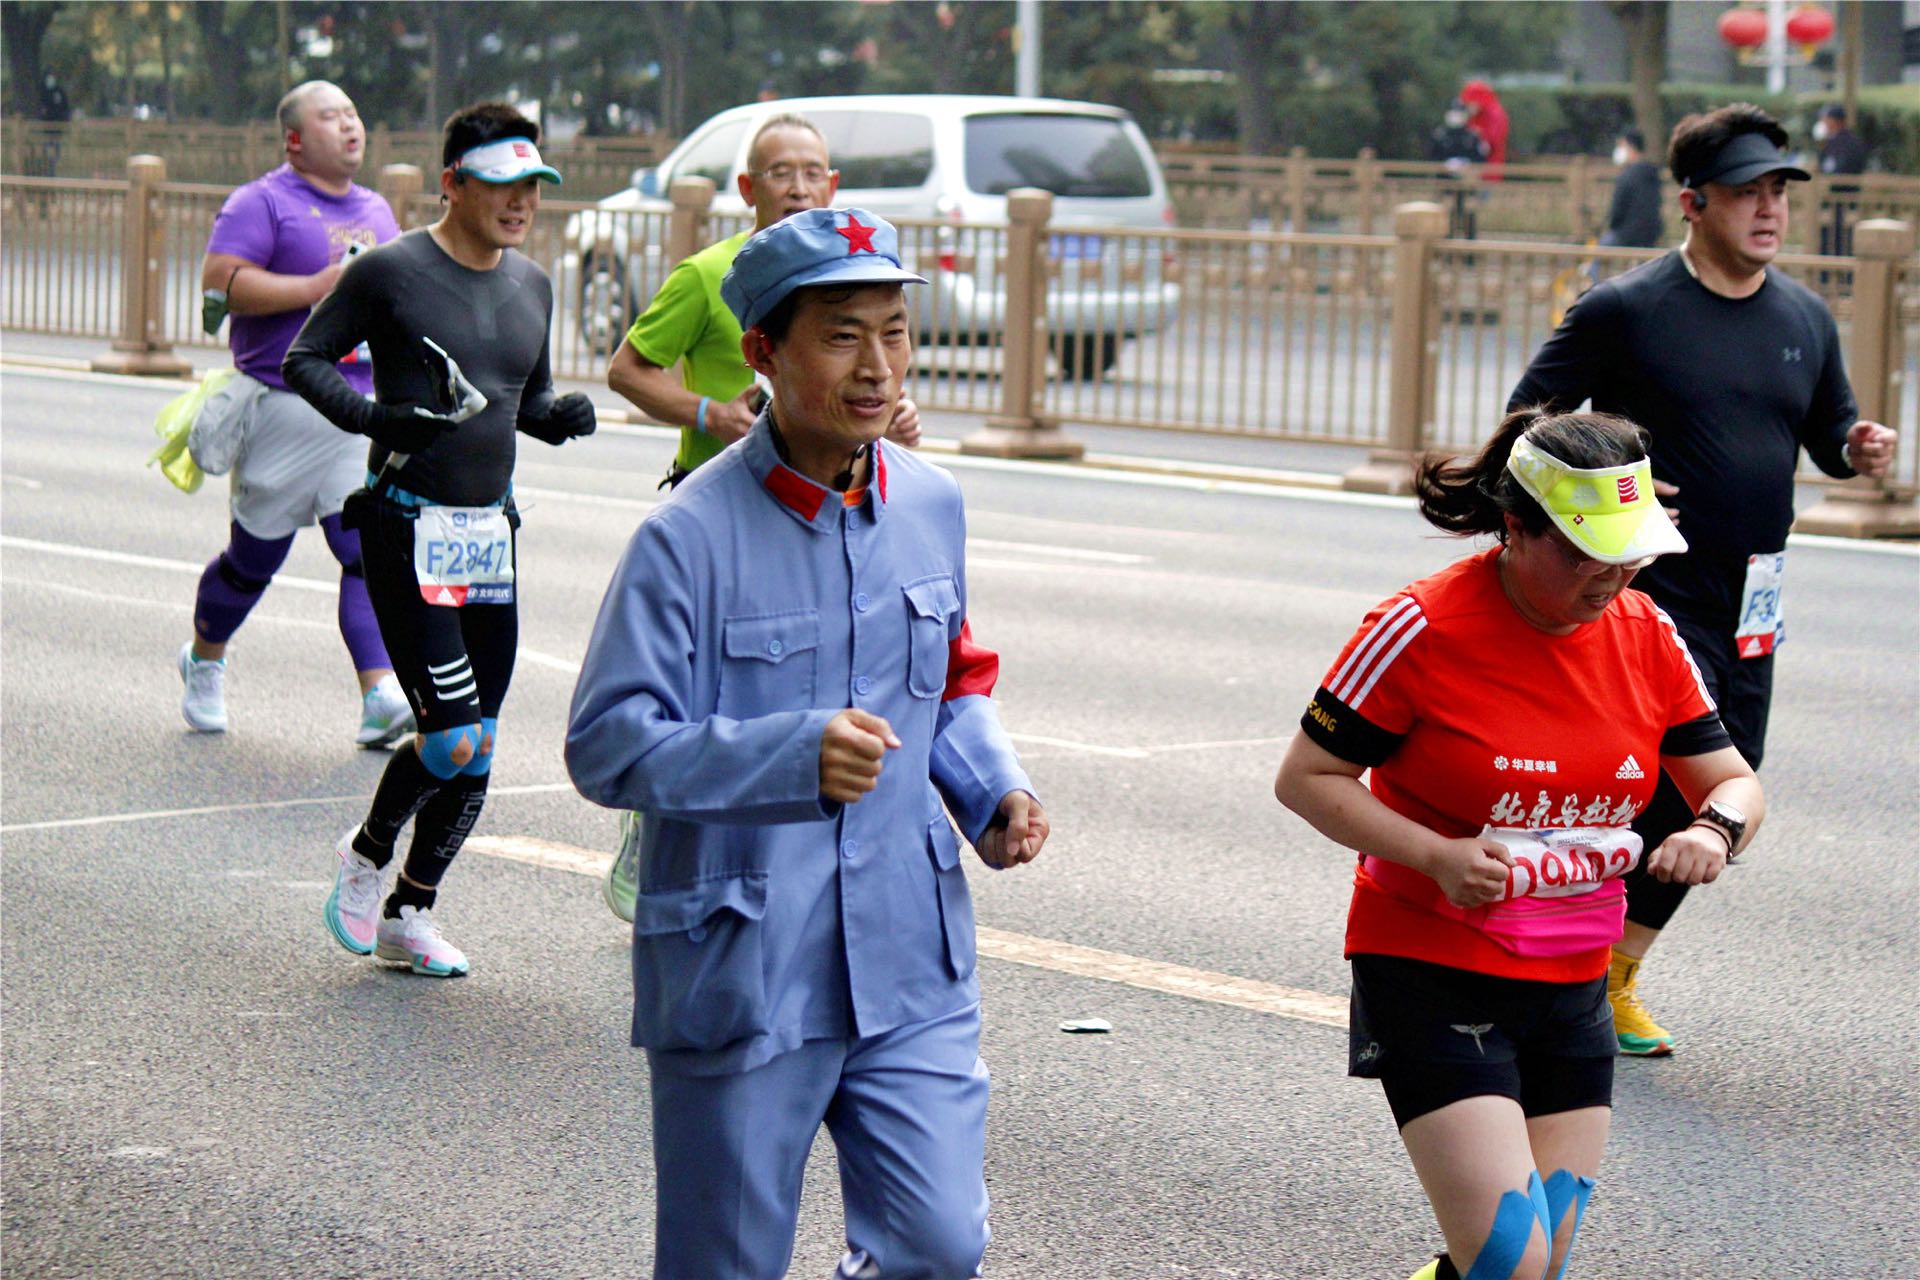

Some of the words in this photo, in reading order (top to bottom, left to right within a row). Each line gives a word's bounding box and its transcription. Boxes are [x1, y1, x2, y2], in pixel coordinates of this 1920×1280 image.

[427, 541, 507, 575] F2847
[1743, 588, 1781, 624] F3
[1511, 758, 1557, 773] 华夏幸福
[1615, 769, 1645, 779] adidas
